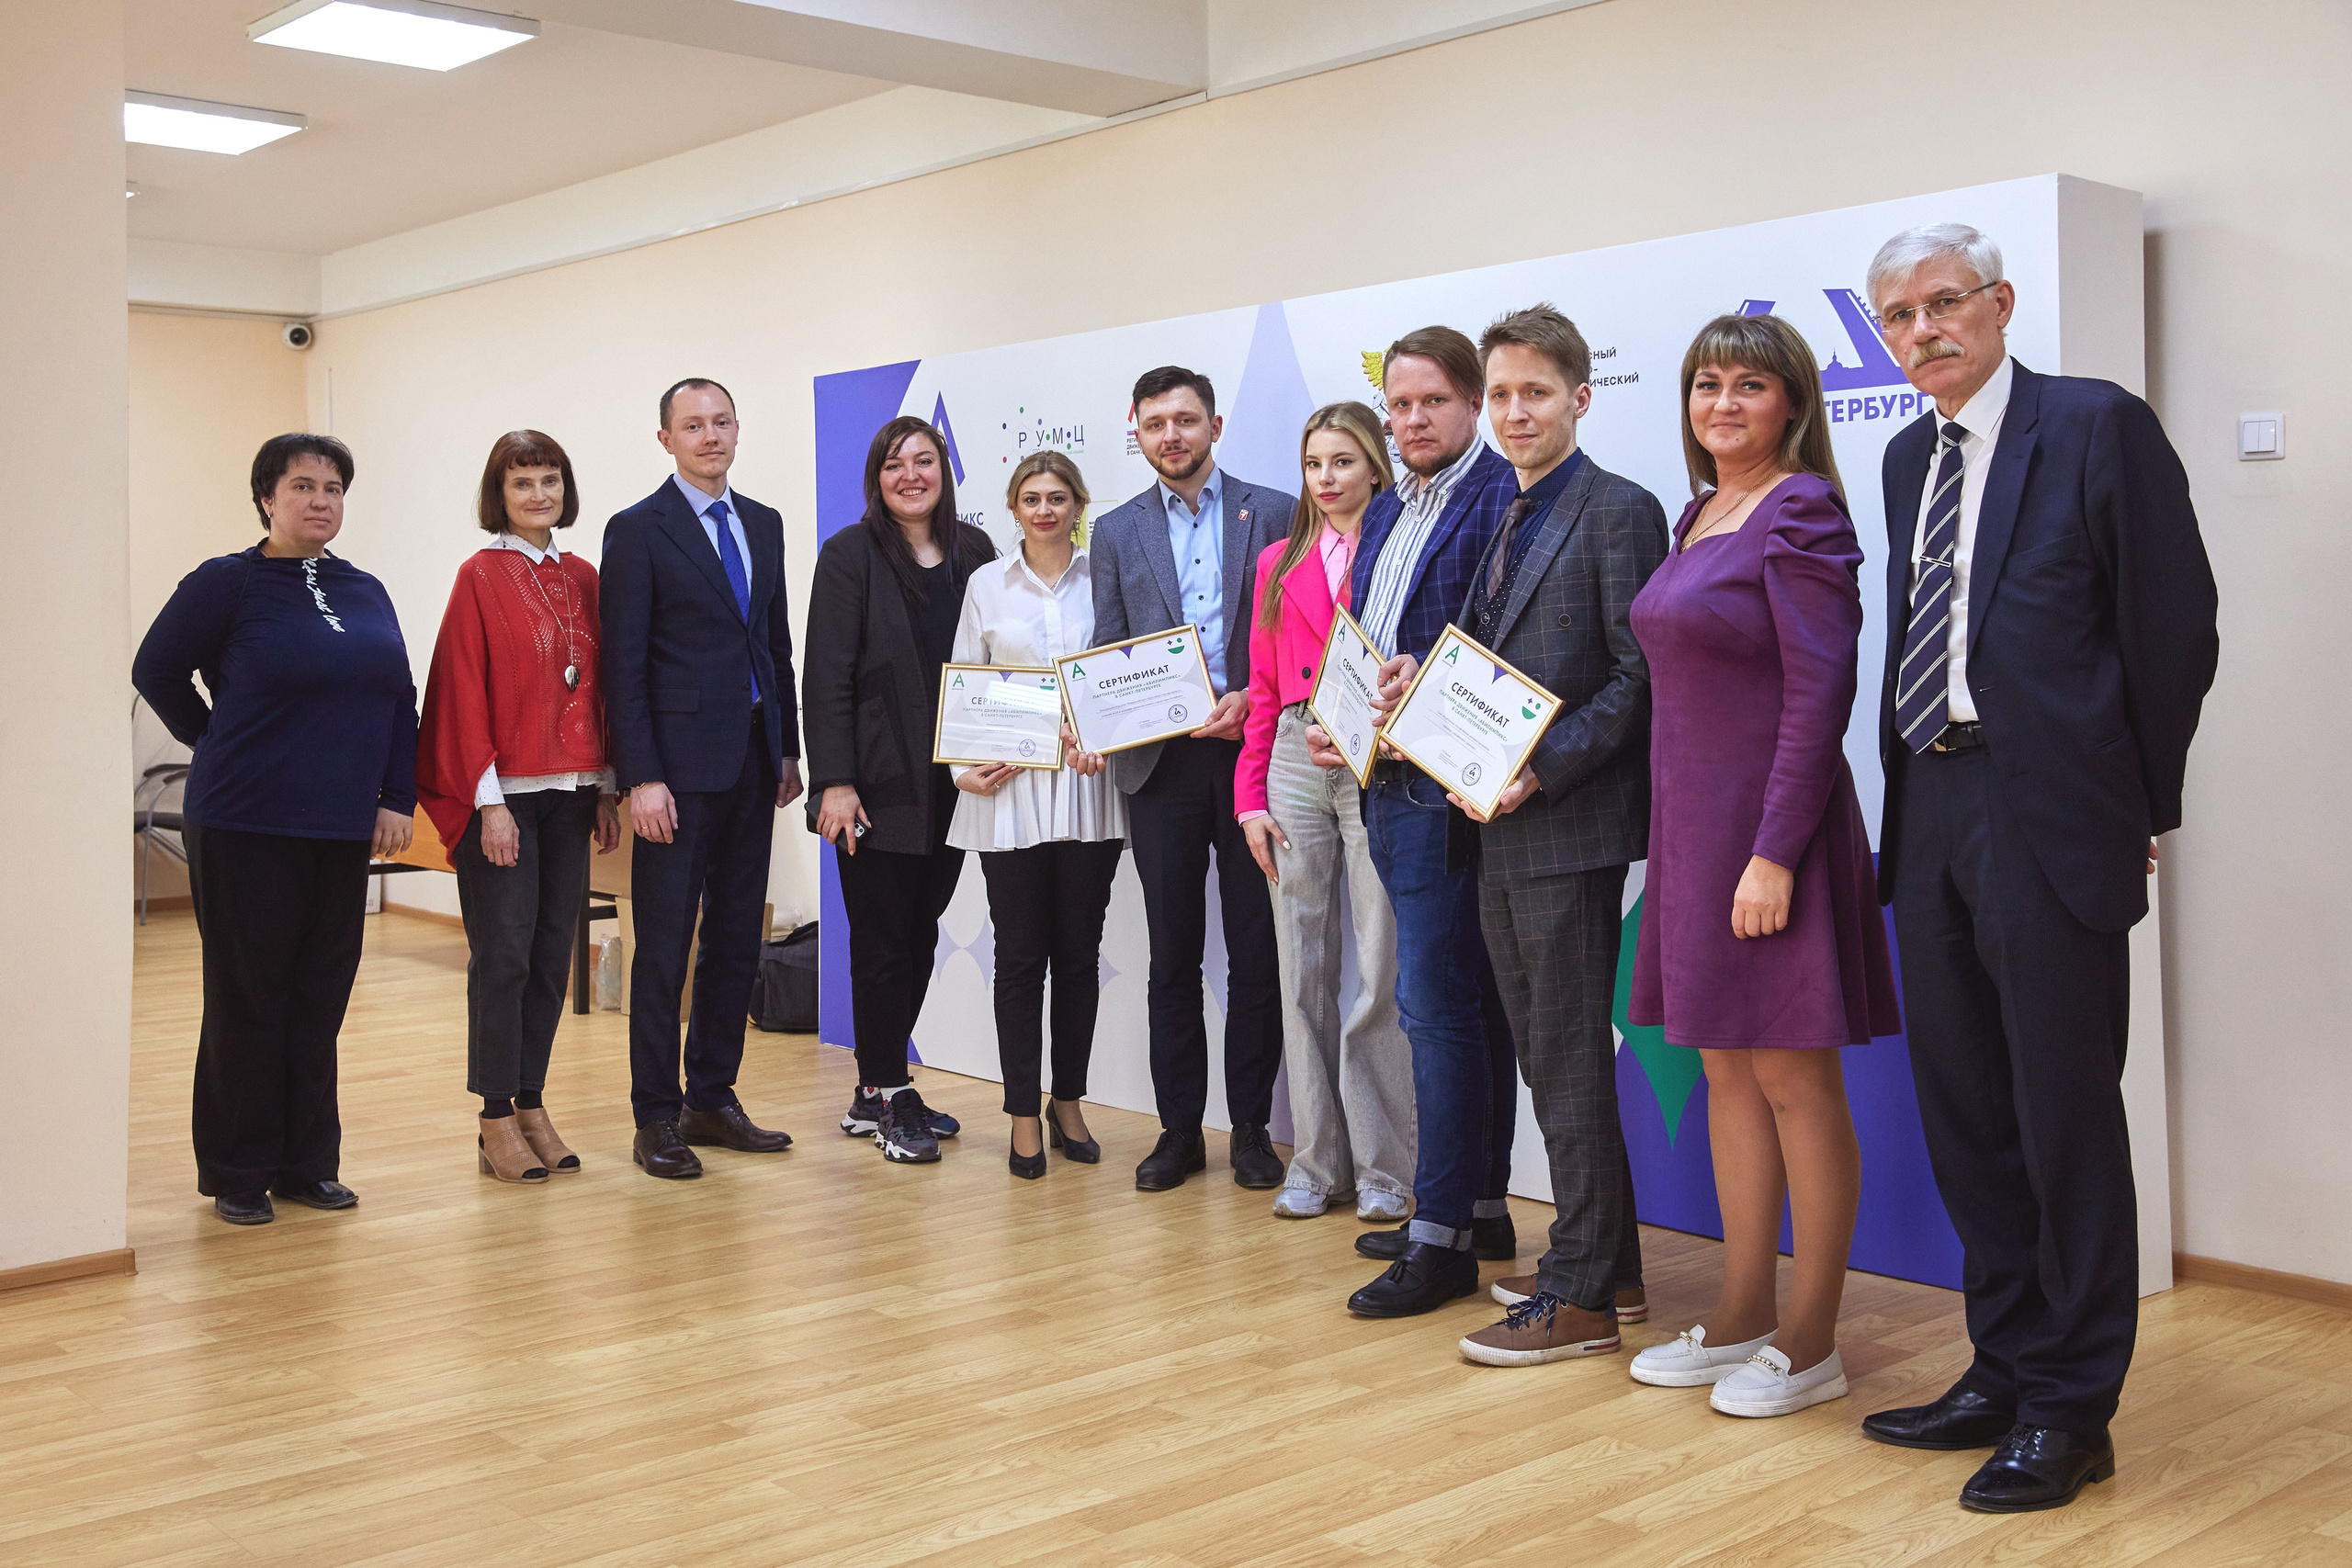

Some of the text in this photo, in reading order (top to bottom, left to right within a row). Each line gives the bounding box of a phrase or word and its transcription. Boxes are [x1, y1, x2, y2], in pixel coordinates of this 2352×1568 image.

[1099, 664, 1170, 690] СЕРТИФИКАТ
[1342, 658, 1374, 701] СЕРТИФИКАТ
[1451, 682, 1510, 728] СЕРТИФИКАТ
